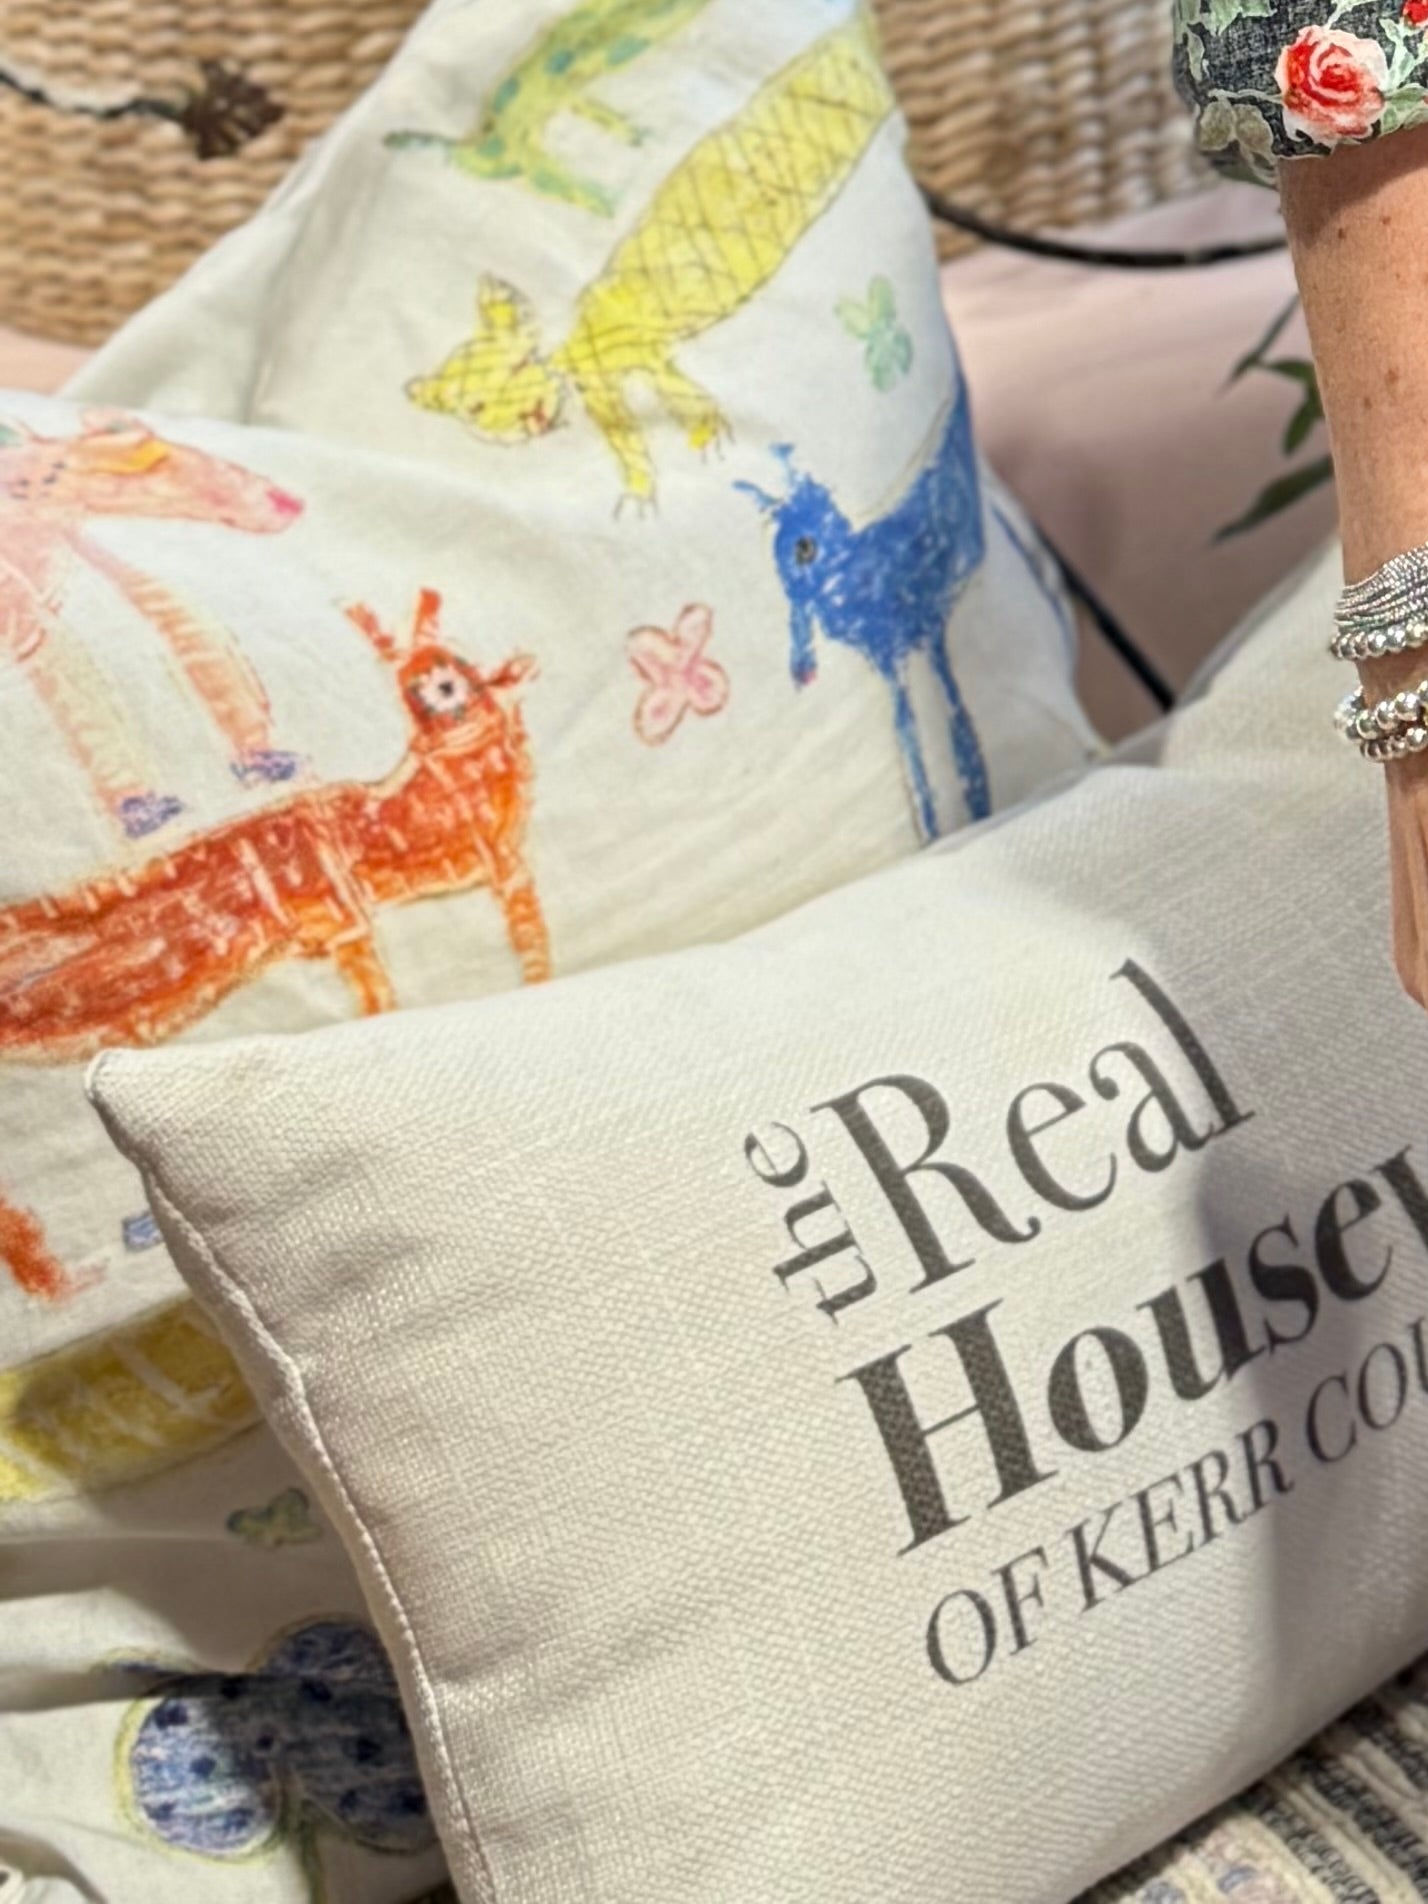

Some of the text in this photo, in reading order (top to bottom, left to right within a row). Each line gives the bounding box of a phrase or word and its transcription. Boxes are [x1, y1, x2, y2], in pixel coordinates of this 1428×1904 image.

[744, 1122, 878, 1326] the
[810, 958, 1255, 1294] Real
[925, 1546, 1049, 1686] OF
[1066, 1418, 1296, 1613] KERR
